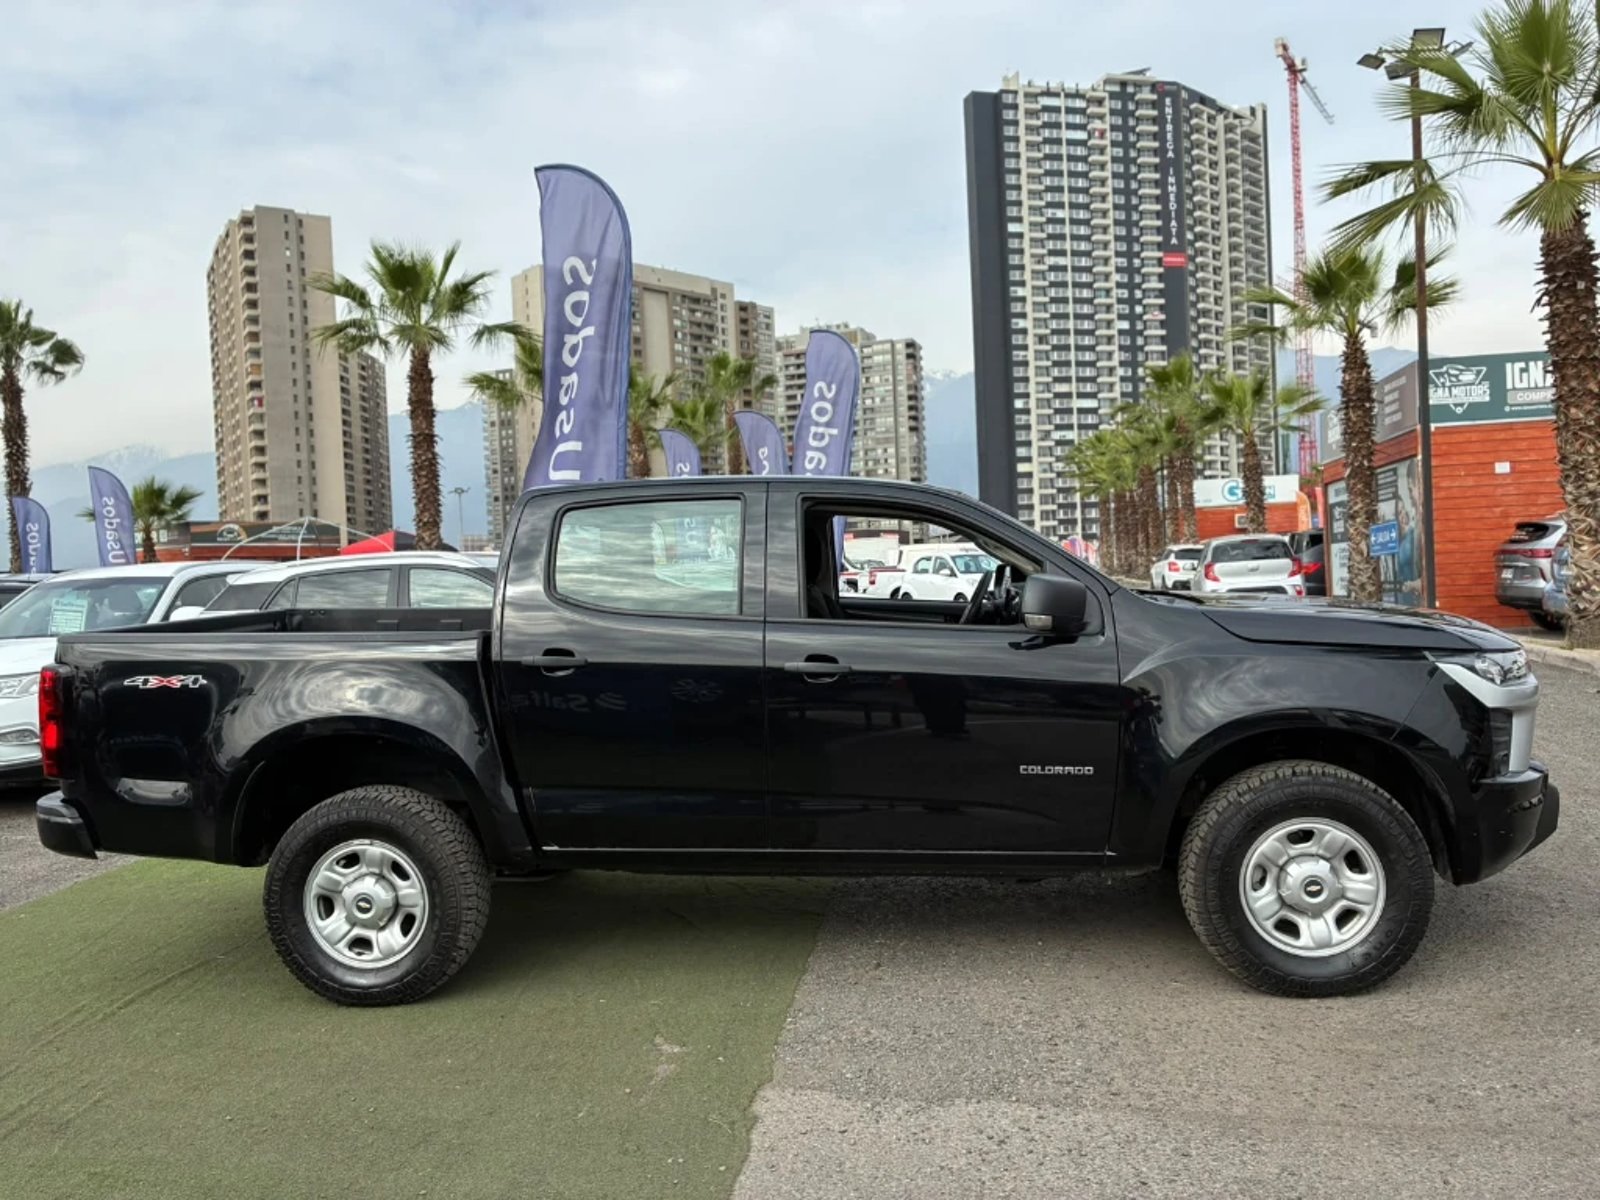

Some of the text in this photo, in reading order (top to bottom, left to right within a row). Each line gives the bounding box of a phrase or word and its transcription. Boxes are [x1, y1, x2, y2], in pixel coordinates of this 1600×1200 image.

[1165, 98, 1175, 158] ENTREGA
[1167, 167, 1178, 245] INMEDIATA
[1451, 384, 1490, 399] MOTORS
[1019, 764, 1094, 775] COLORADO
